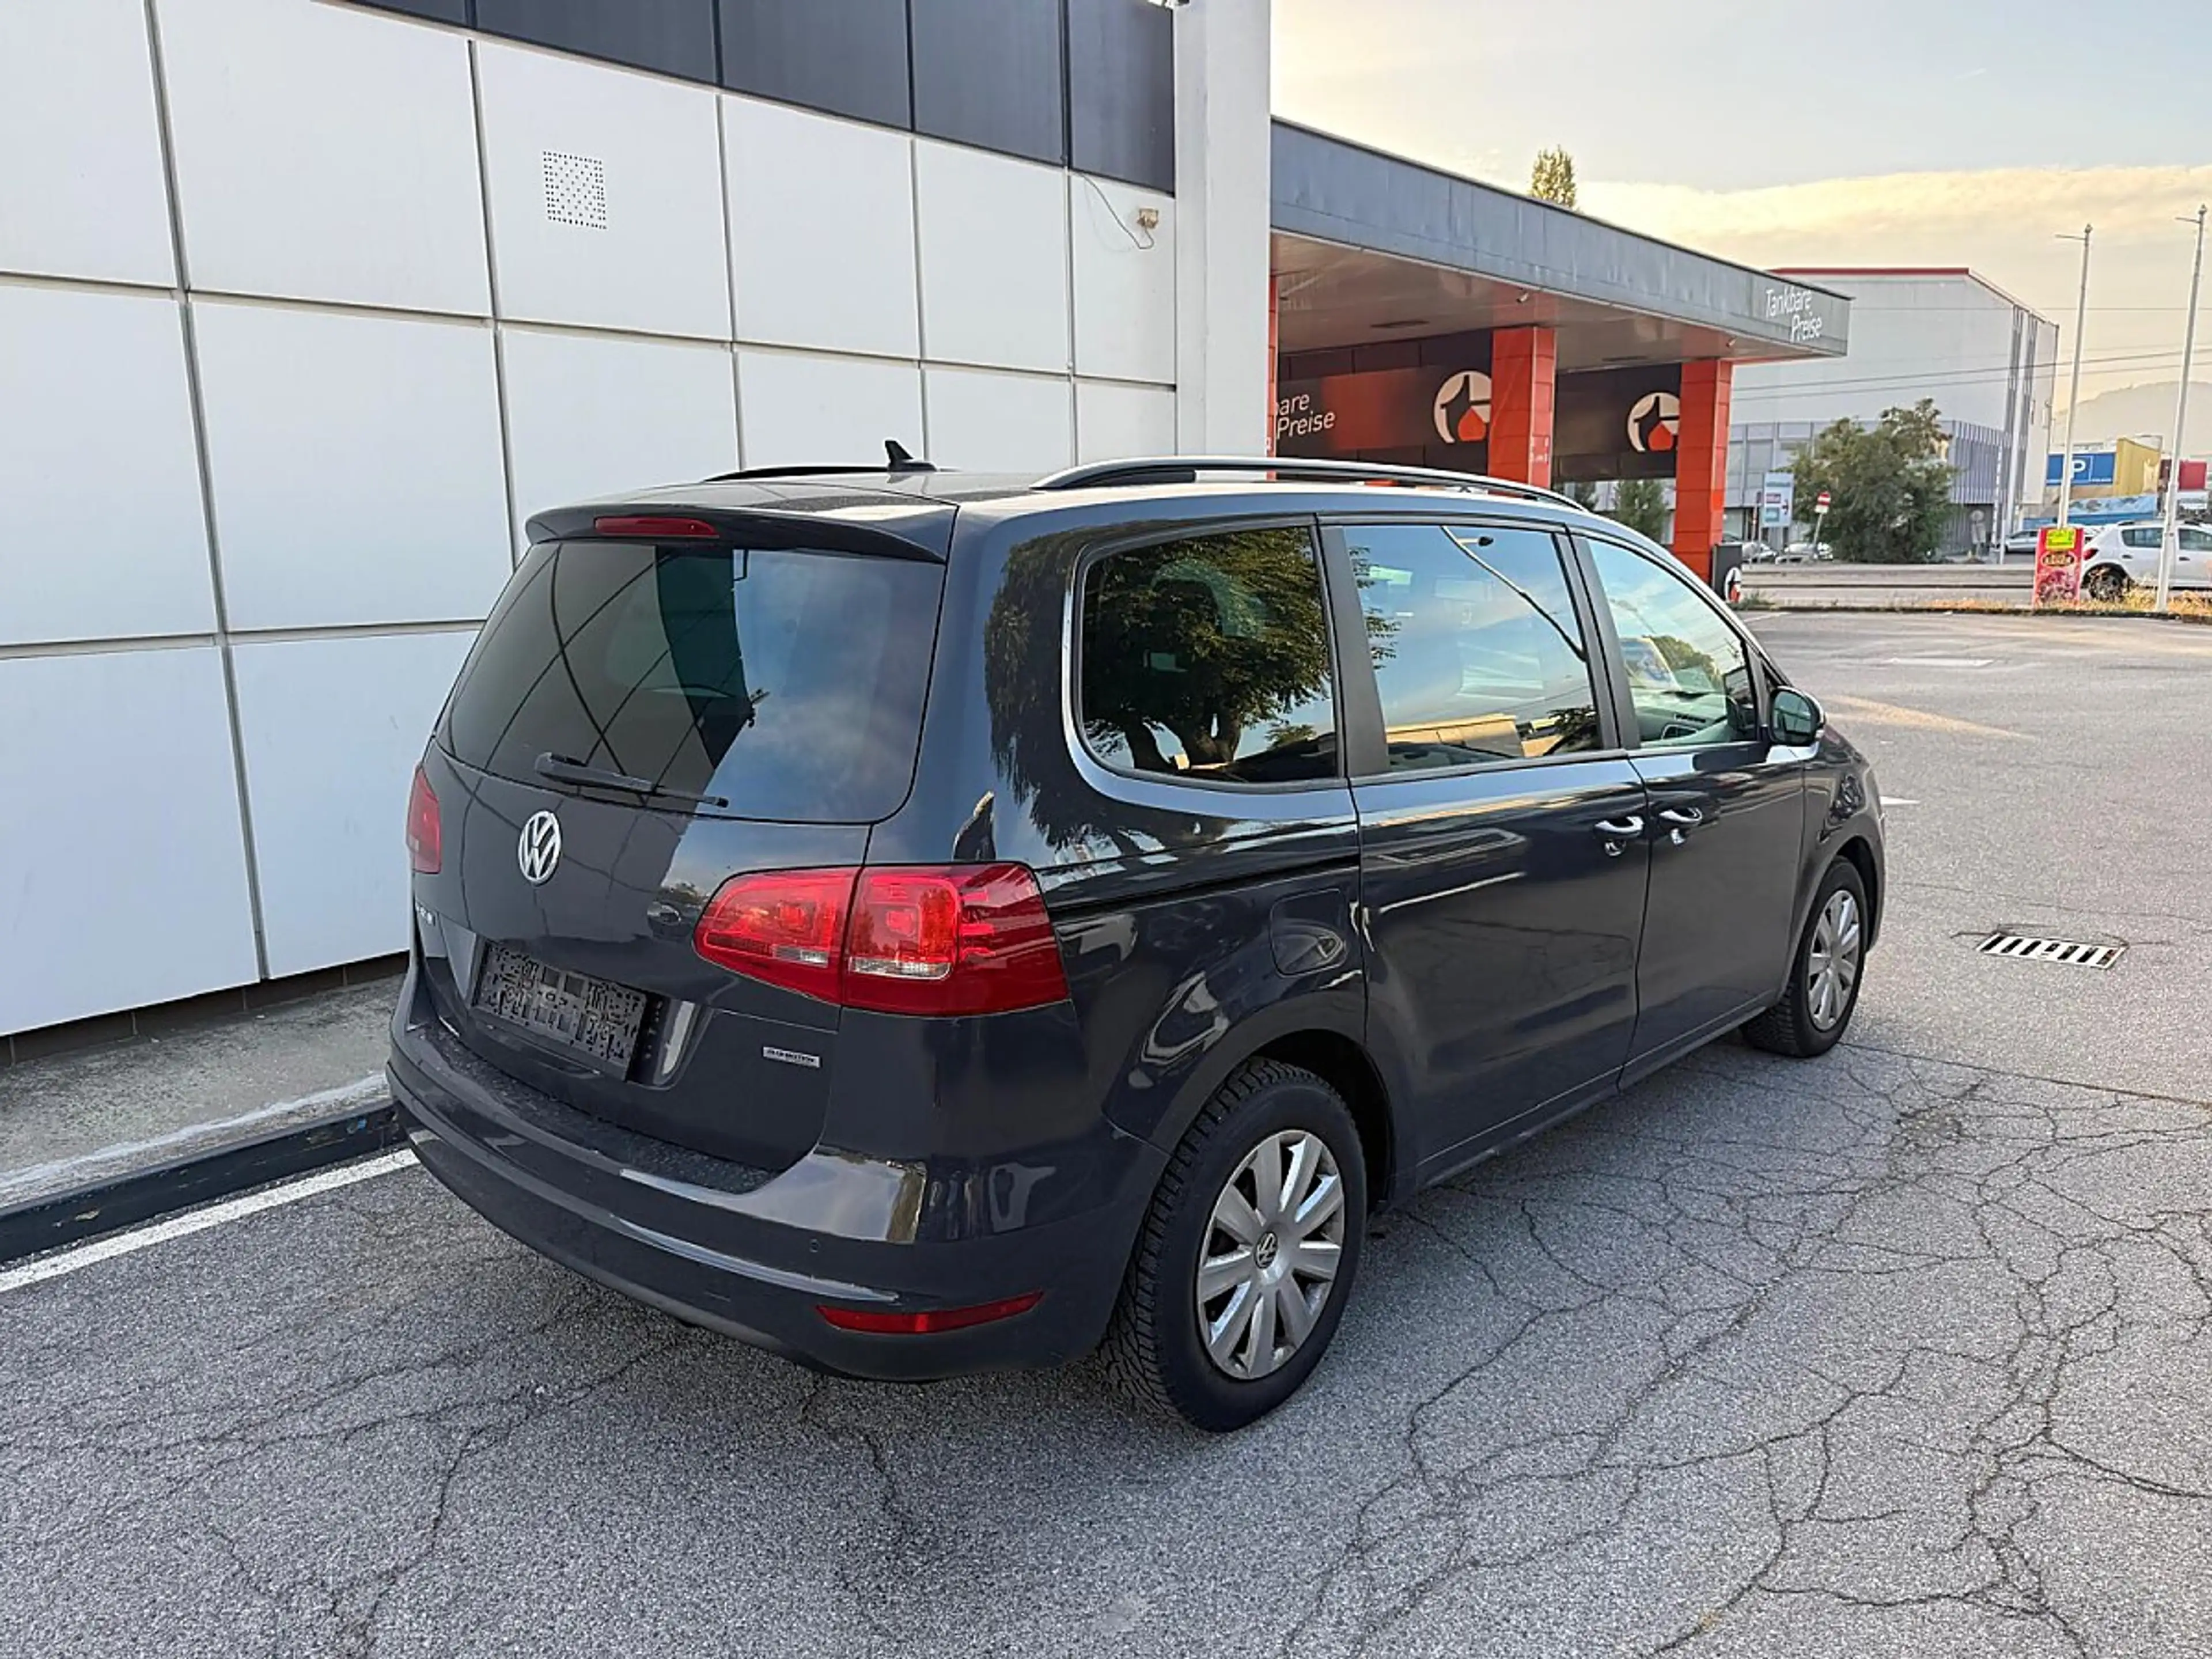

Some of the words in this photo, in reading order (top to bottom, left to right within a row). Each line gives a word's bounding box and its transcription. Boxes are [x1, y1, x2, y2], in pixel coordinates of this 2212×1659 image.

[1766, 286, 1812, 318] Tankbare
[1790, 312, 1822, 342] Preise
[1276, 394, 1310, 415] are
[1277, 411, 1336, 440] Preise
[2071, 460, 2086, 479] P
[518, 810, 561, 882] VW
